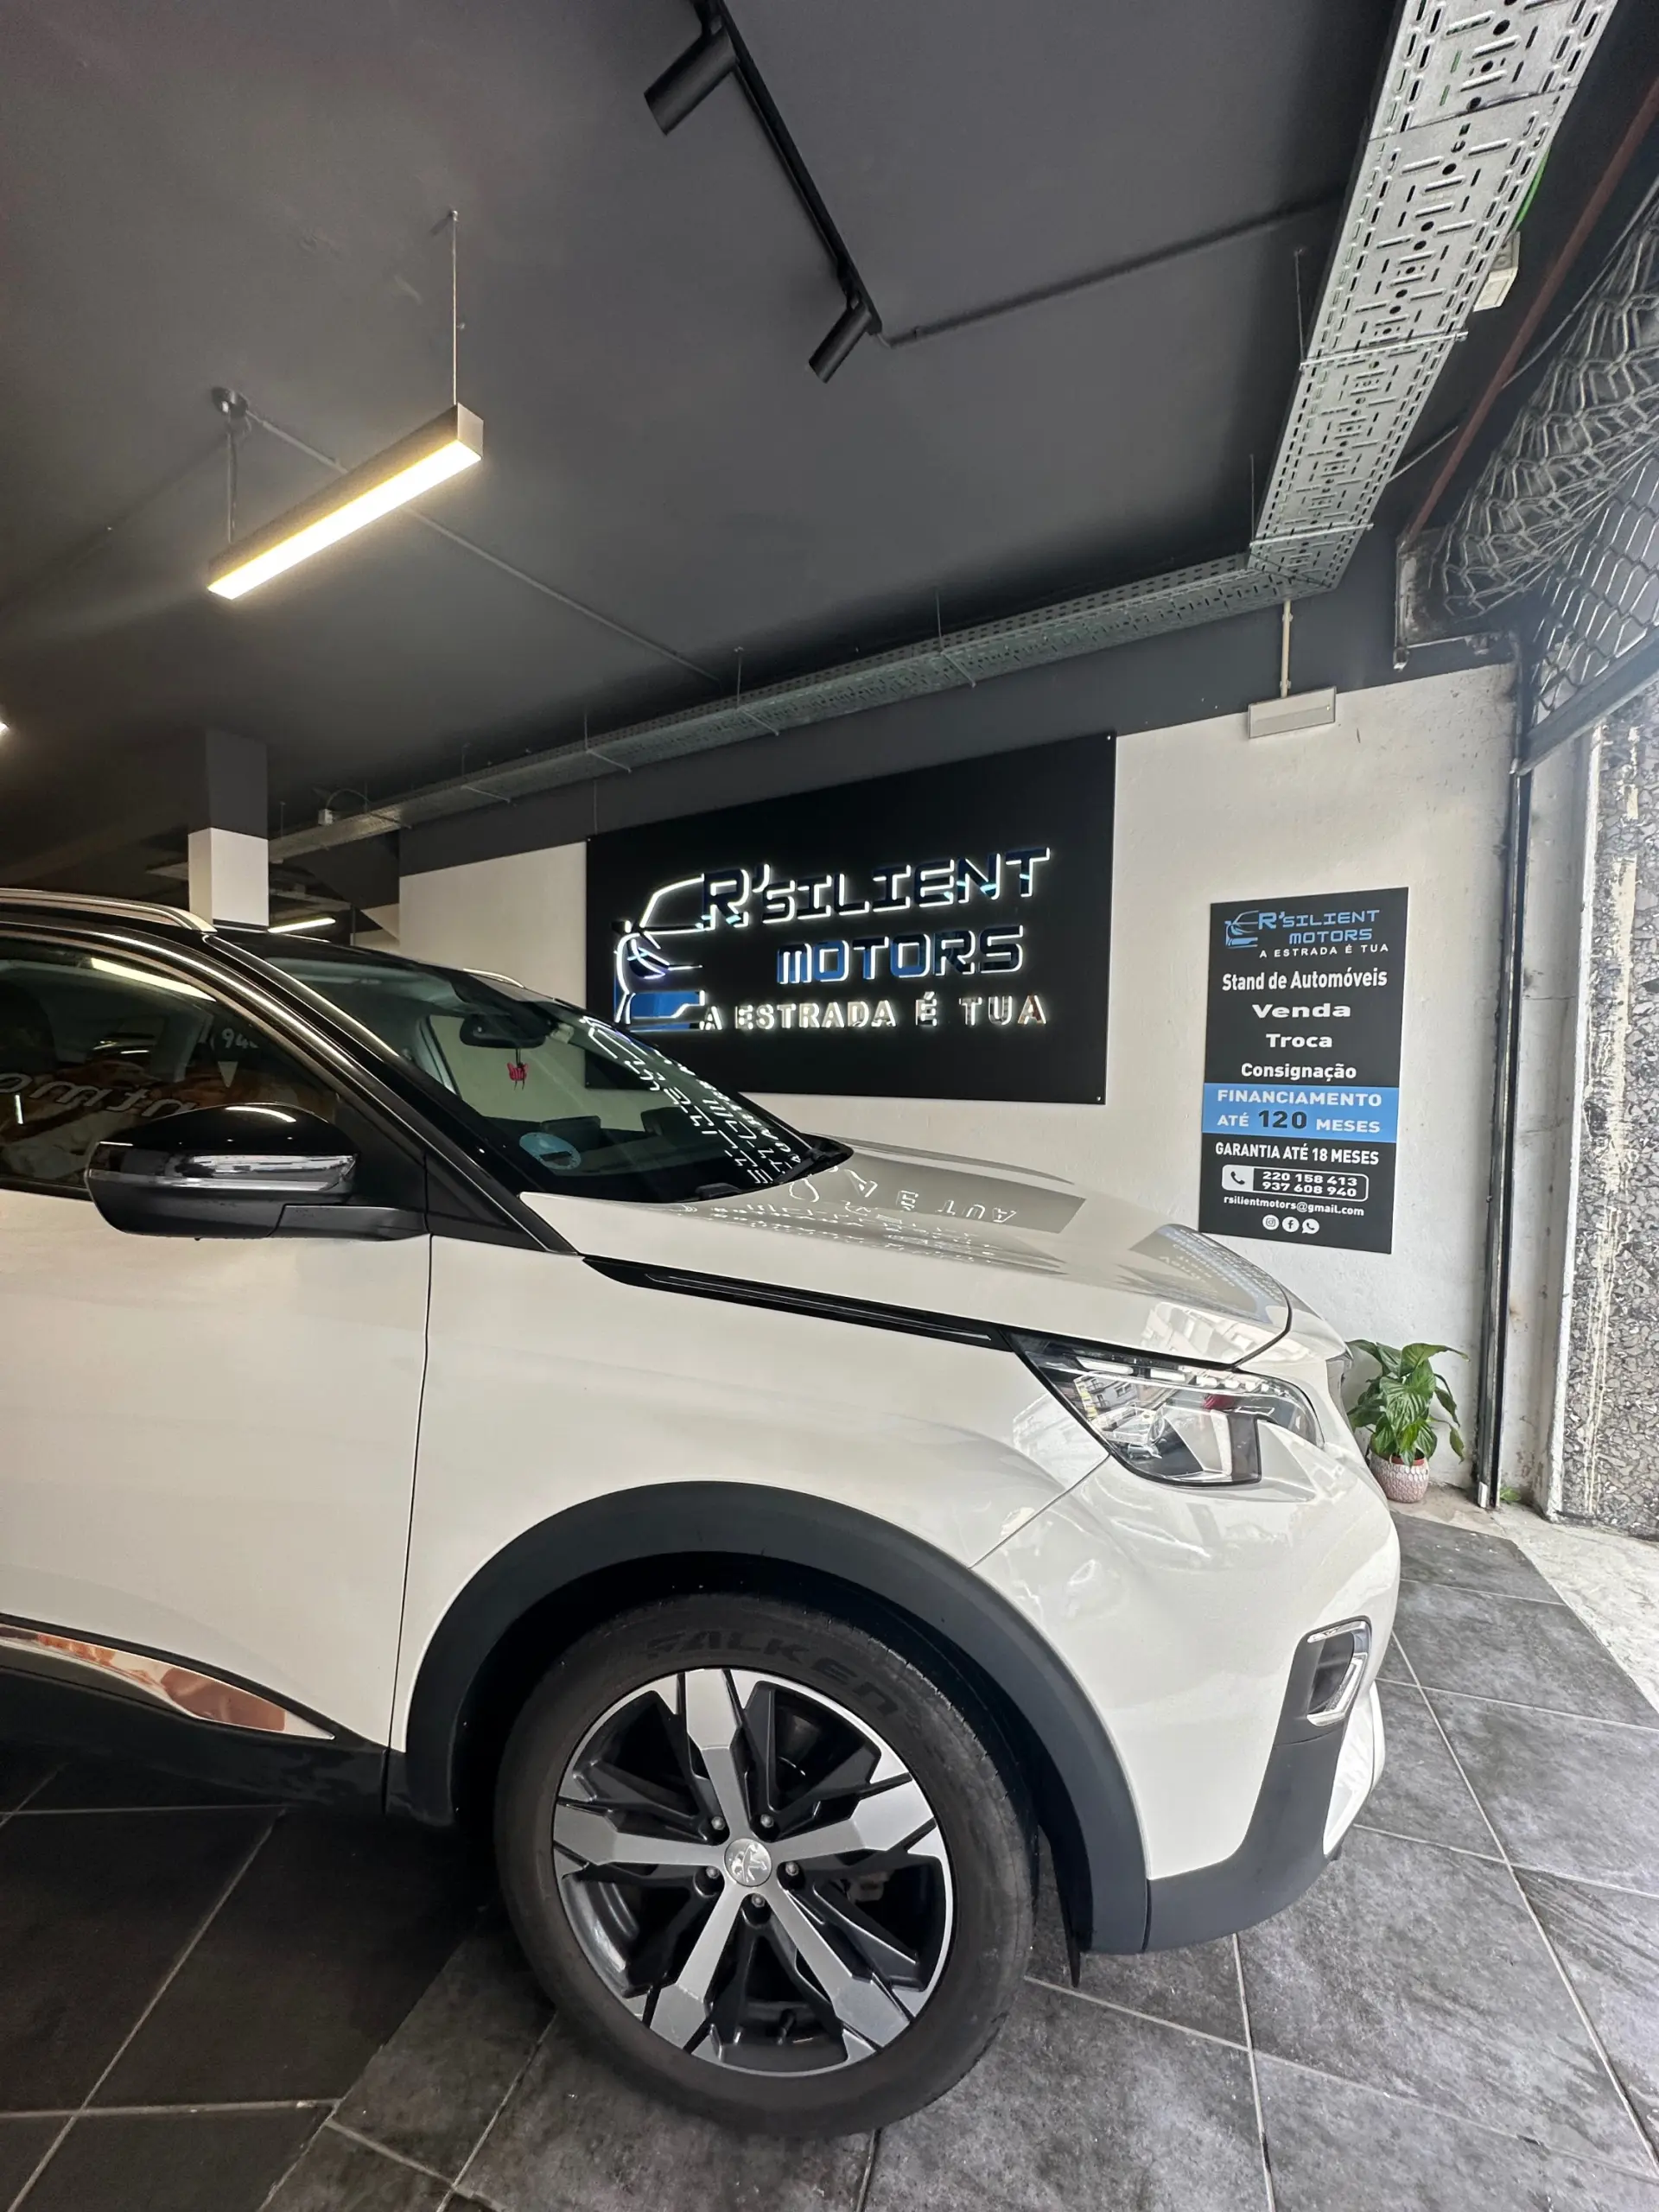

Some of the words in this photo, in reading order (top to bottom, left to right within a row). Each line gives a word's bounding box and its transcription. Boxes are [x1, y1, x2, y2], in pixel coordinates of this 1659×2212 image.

[1288, 928, 1373, 945] MOTORS
[778, 925, 1025, 985] MOTORS
[1259, 950, 1268, 958] A
[1274, 946, 1338, 957] ESTRADA
[1344, 944, 1352, 953] É
[1361, 944, 1389, 953] TUA
[1222, 972, 1265, 991] Stand
[1268, 971, 1287, 989] de
[1290, 967, 1388, 989] Automóveis
[699, 1004, 723, 1032] A
[734, 999, 897, 1032] ESTRADA
[915, 991, 938, 1027] É
[959, 994, 1048, 1027] TUA
[1252, 1003, 1351, 1018] Venda
[1266, 1033, 1332, 1047] Troca
[1241, 1063, 1357, 1082] Consignação
[1217, 1090, 1382, 1107] FINANCIAMENTO
[1217, 1112, 1249, 1128] ATÉ
[1258, 1109, 1307, 1129] 120
[1316, 1119, 1381, 1134] MESES
[1215, 1141, 1281, 1159] GARANTIA
[1282, 1143, 1309, 1160] ATÉ
[1312, 1147, 1328, 1162] 18
[1331, 1148, 1380, 1166] MESES
[1262, 1171, 1291, 1181] 220
[1294, 1173, 1324, 1184] 158
[1326, 1176, 1357, 1186] 413
[1262, 1181, 1290, 1192] 937
[1294, 1184, 1323, 1194] 608
[1327, 1186, 1357, 1197] 940
[1224, 1196, 1365, 1217] rsilientmotors@gmail.com
